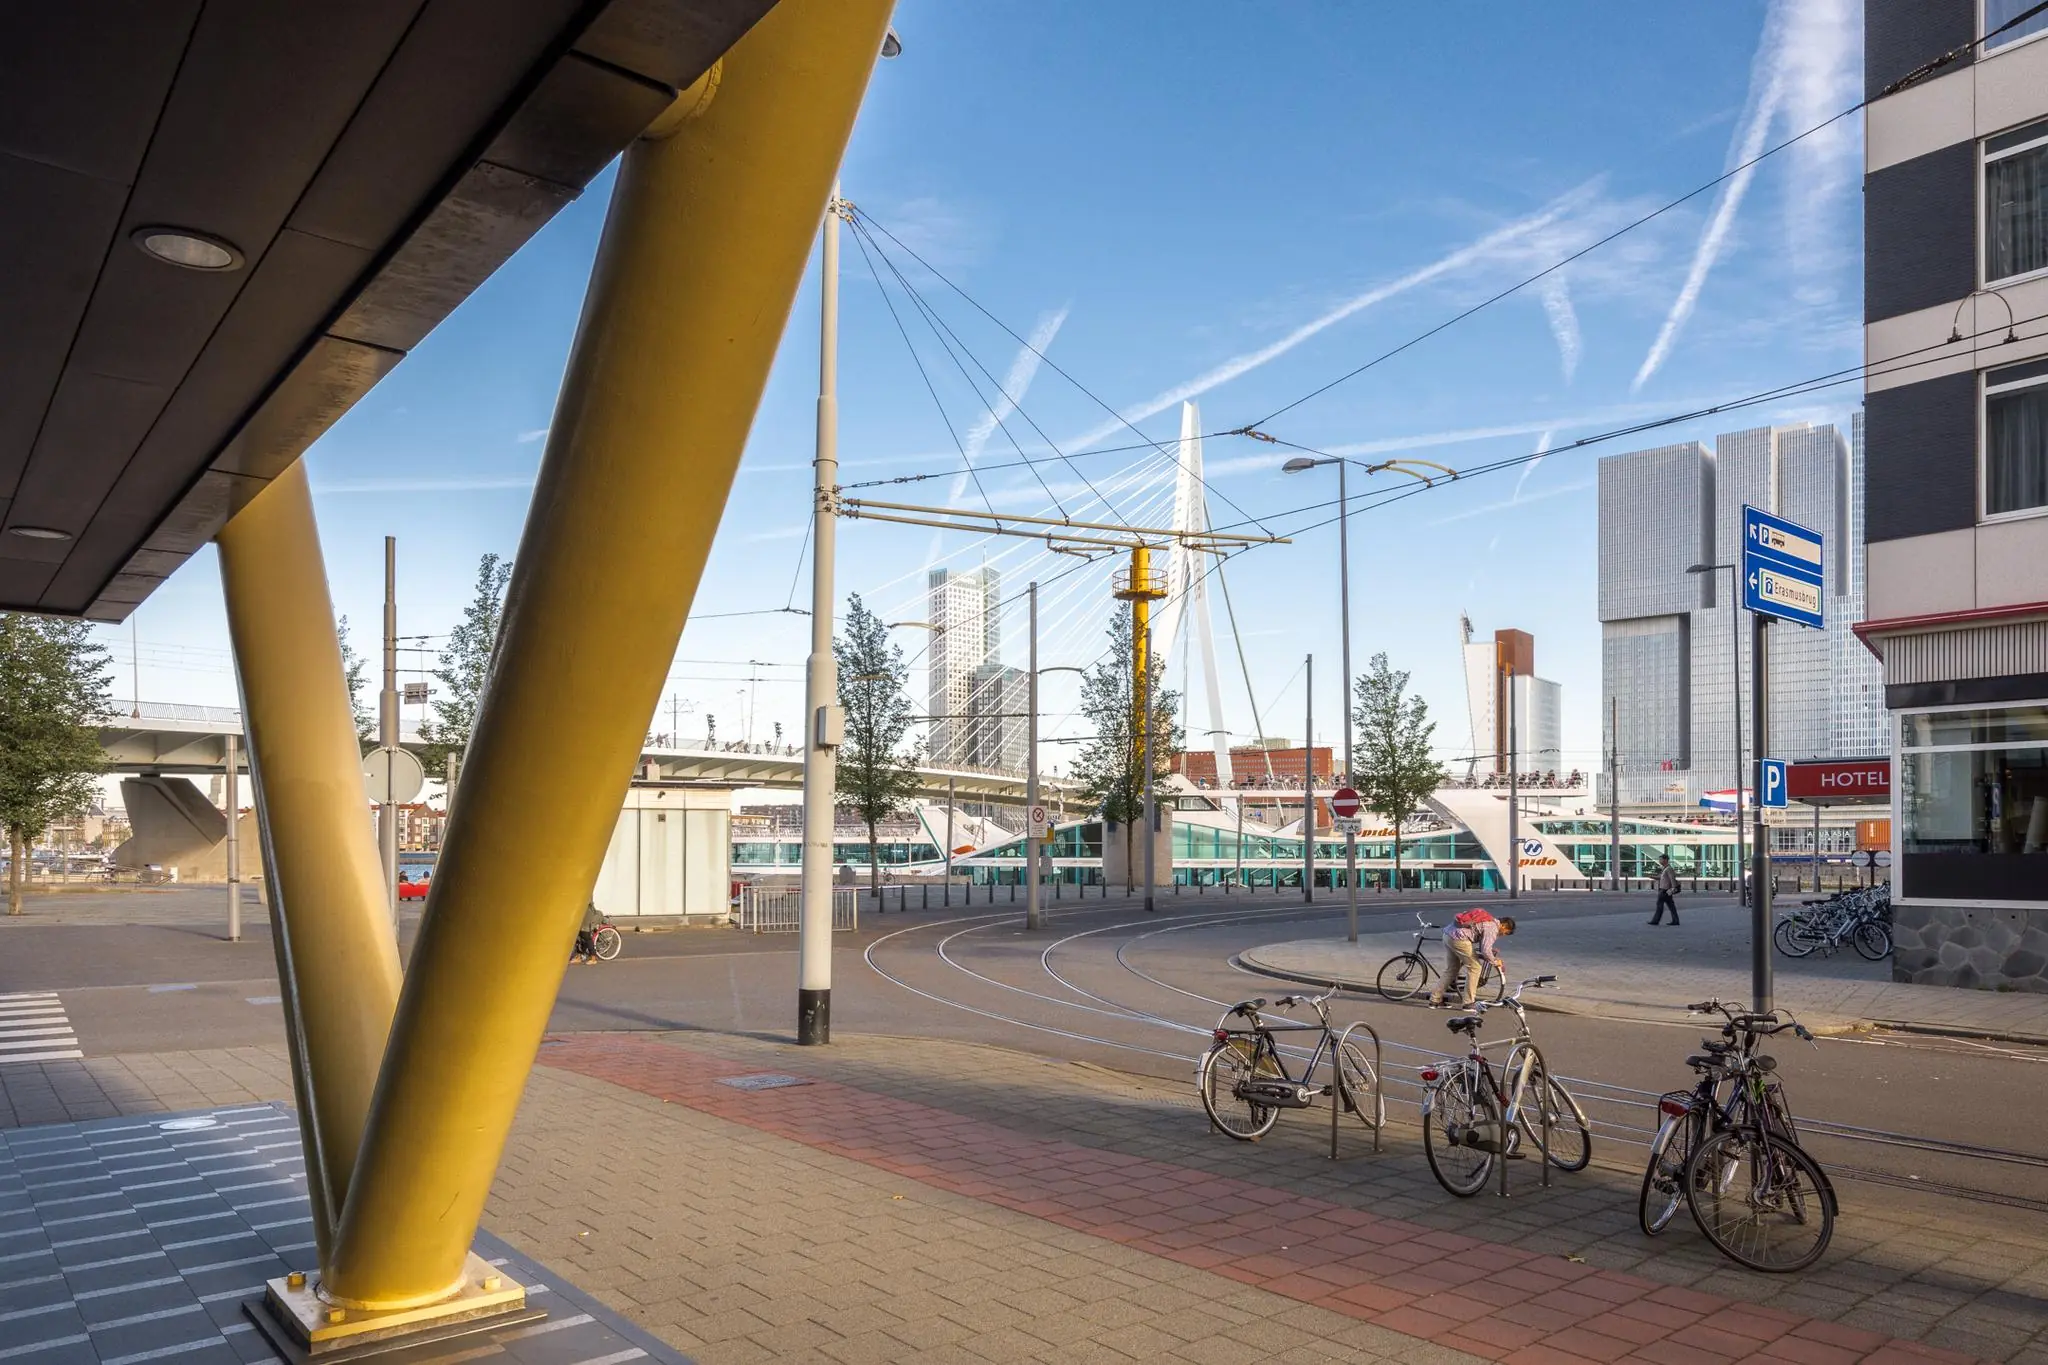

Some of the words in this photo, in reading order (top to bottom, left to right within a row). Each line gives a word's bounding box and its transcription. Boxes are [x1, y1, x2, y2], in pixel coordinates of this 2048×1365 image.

[1774, 582, 1817, 608] Erasmusbrug
[1767, 765, 1781, 801] P
[1821, 771, 1889, 787] HOTEL
[1808, 830, 1830, 838] AUA
